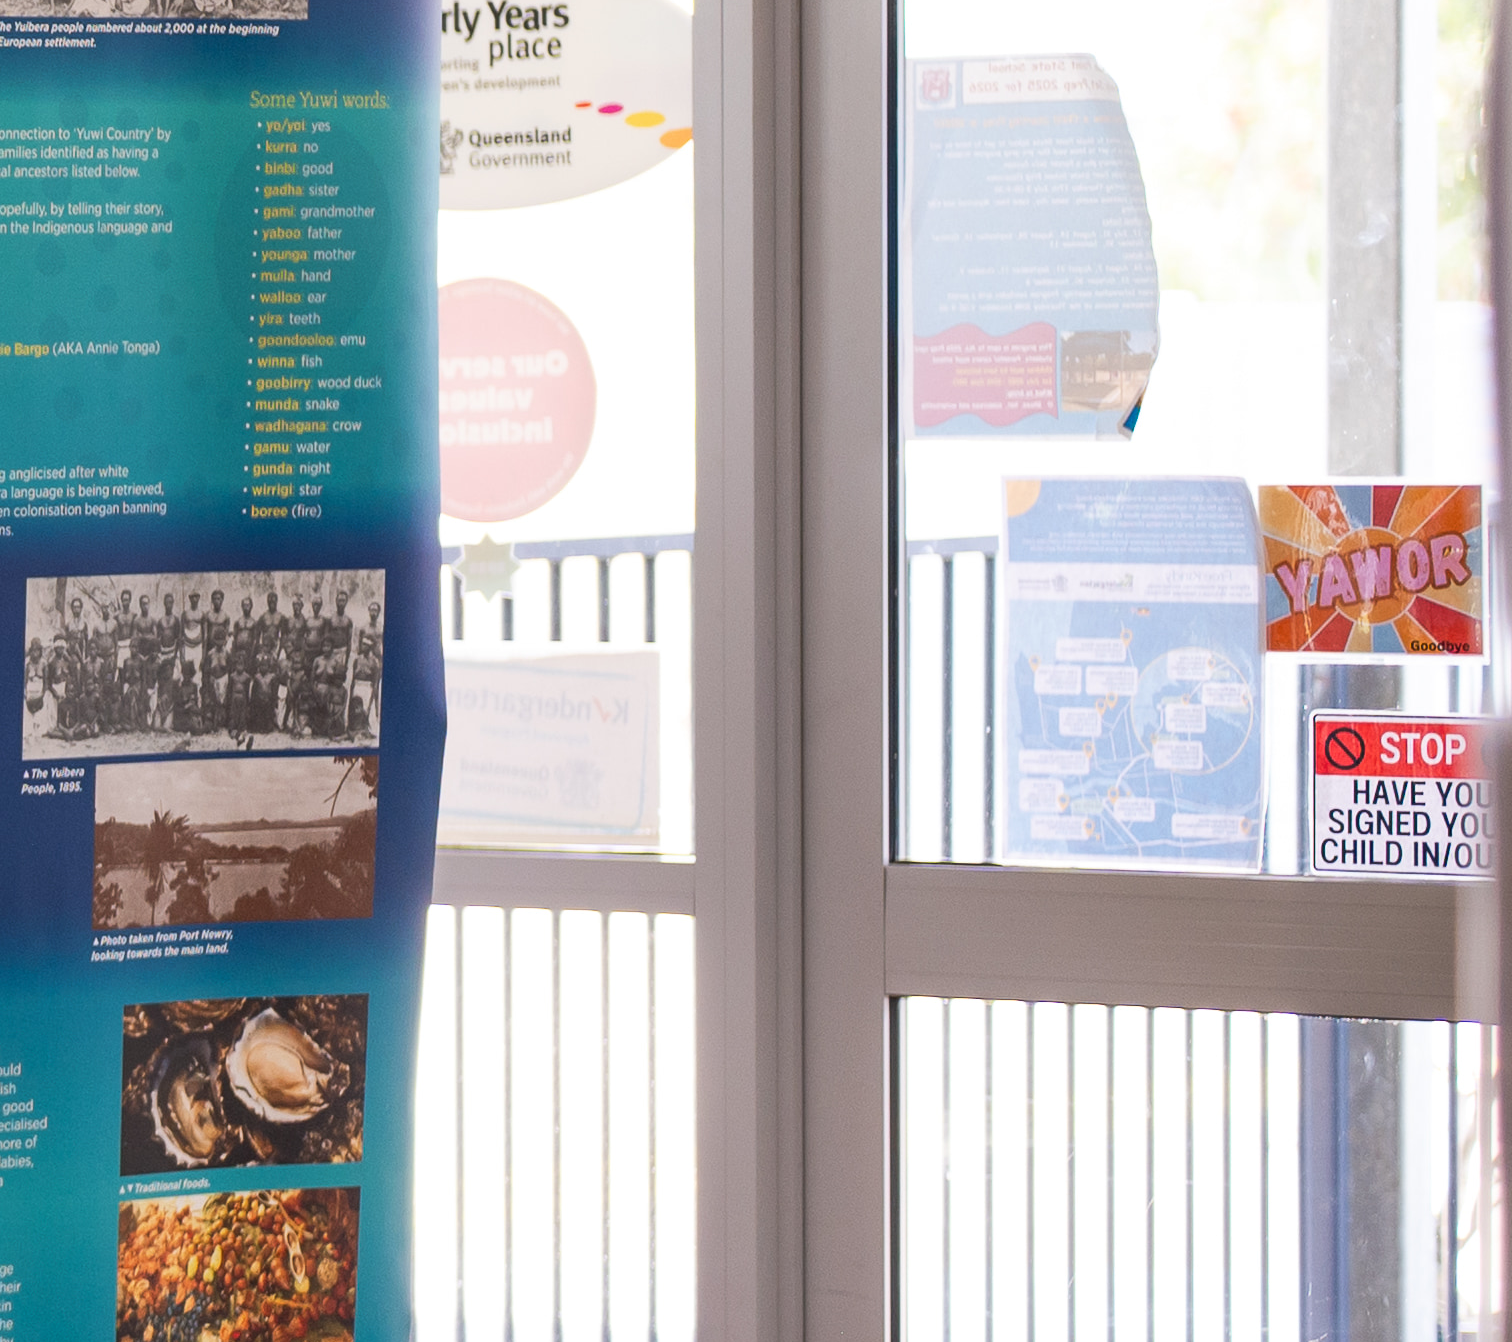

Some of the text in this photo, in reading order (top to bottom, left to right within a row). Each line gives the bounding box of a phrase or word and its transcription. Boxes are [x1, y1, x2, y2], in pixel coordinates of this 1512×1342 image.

[486, 0, 570, 31] Years
[488, 32, 563, 68] place
[248, 89, 391, 110] Some Yuwi words:
[302, 142, 319, 153] no
[469, 125, 572, 147] Queensland
[301, 161, 333, 177] good
[469, 149, 572, 169] Government
[1275, 532, 1471, 614] YAWOR
[1410, 640, 1471, 655] Goodbye
[1379, 731, 1467, 765] STOP
[1352, 778, 1427, 806] HAVE
[1328, 809, 1432, 837] SIGNED
[1320, 838, 1403, 866] CHILD
[134, 1176, 211, 1194] Traditional foods.
